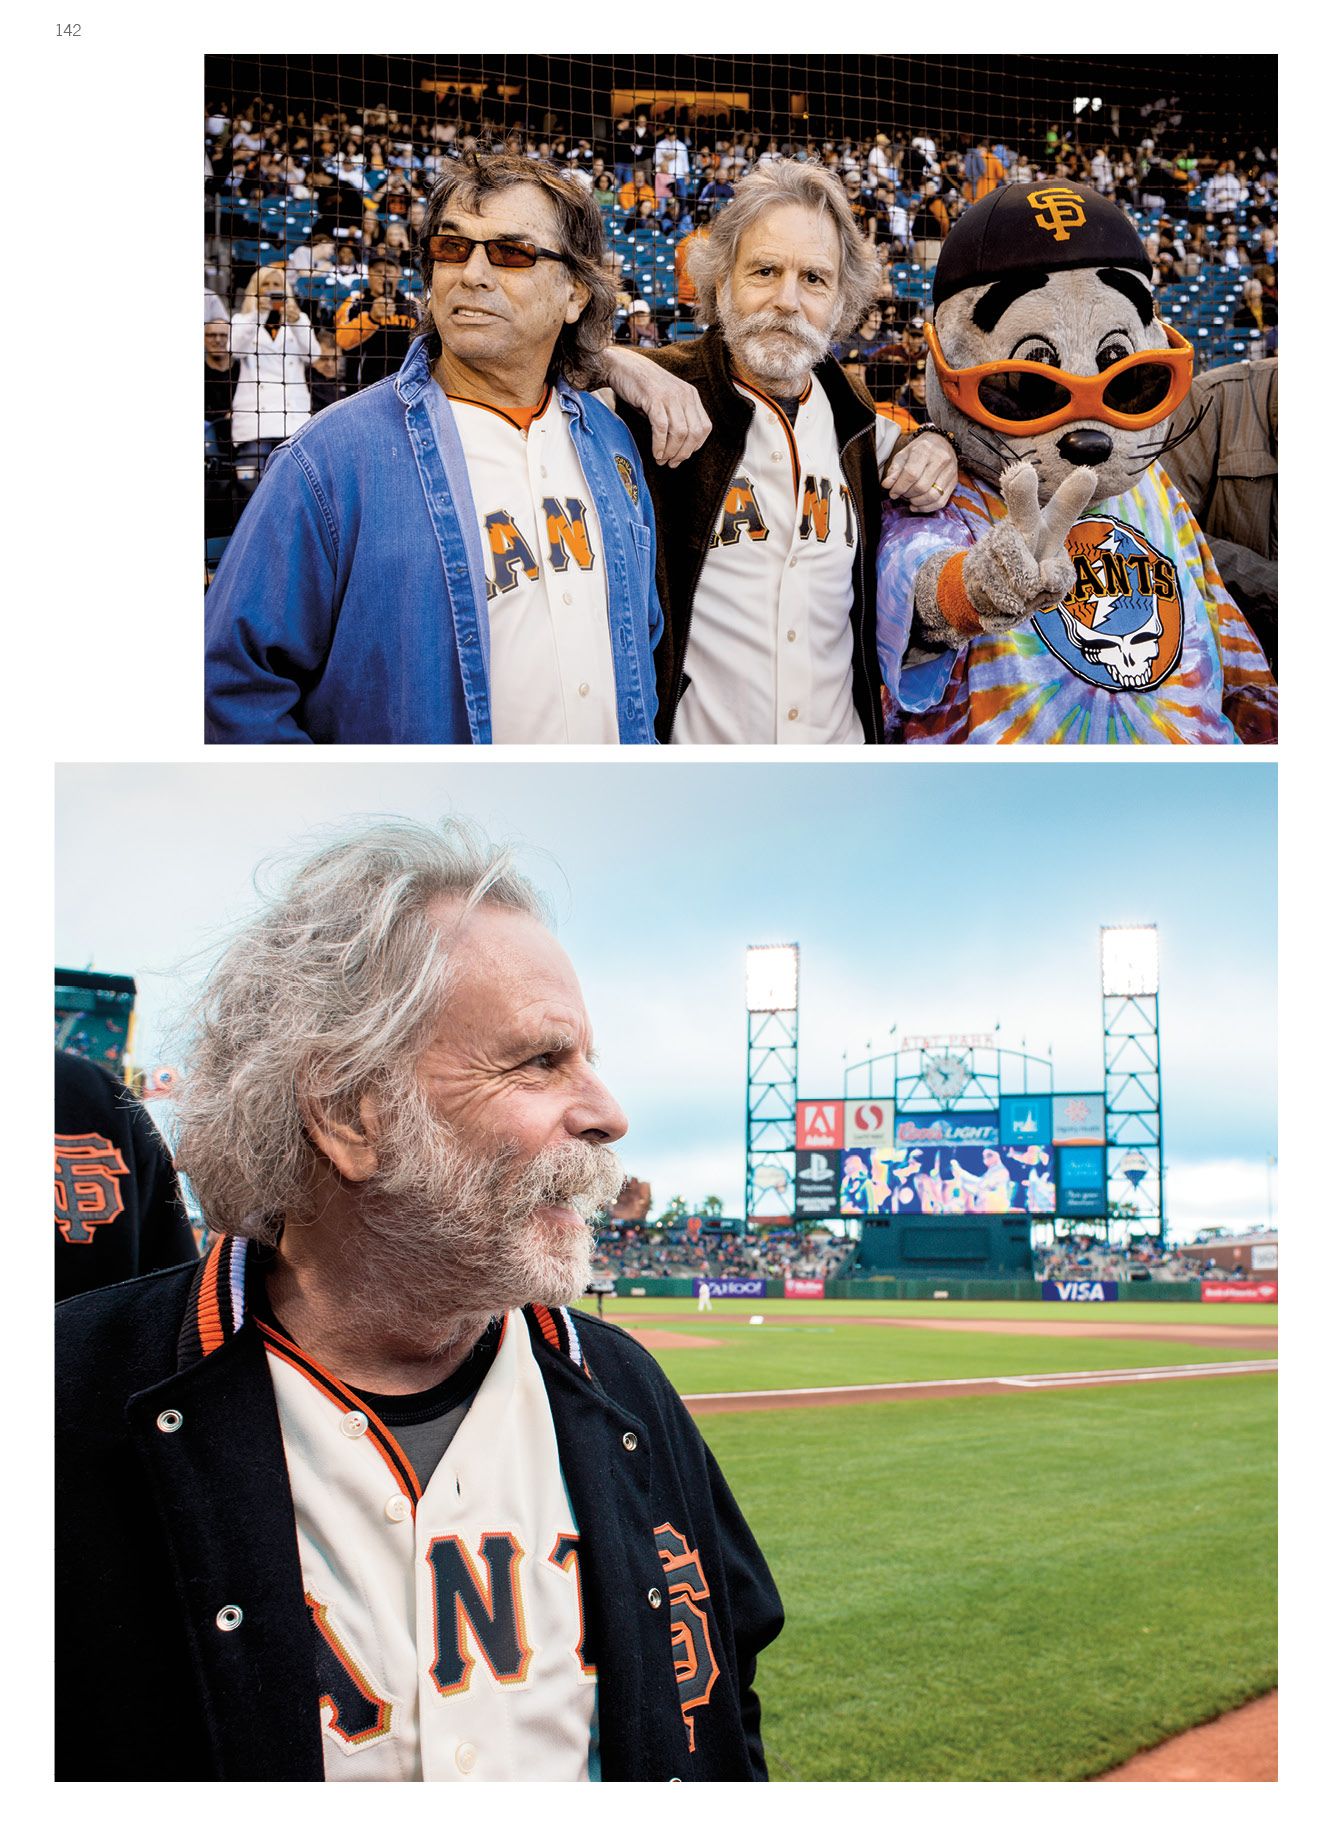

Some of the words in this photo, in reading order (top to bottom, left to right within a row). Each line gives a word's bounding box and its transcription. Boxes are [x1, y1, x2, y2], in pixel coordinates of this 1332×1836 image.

[1026, 187, 1087, 242] SF
[484, 496, 596, 600] AN
[1055, 1281, 1105, 1301] VISA
